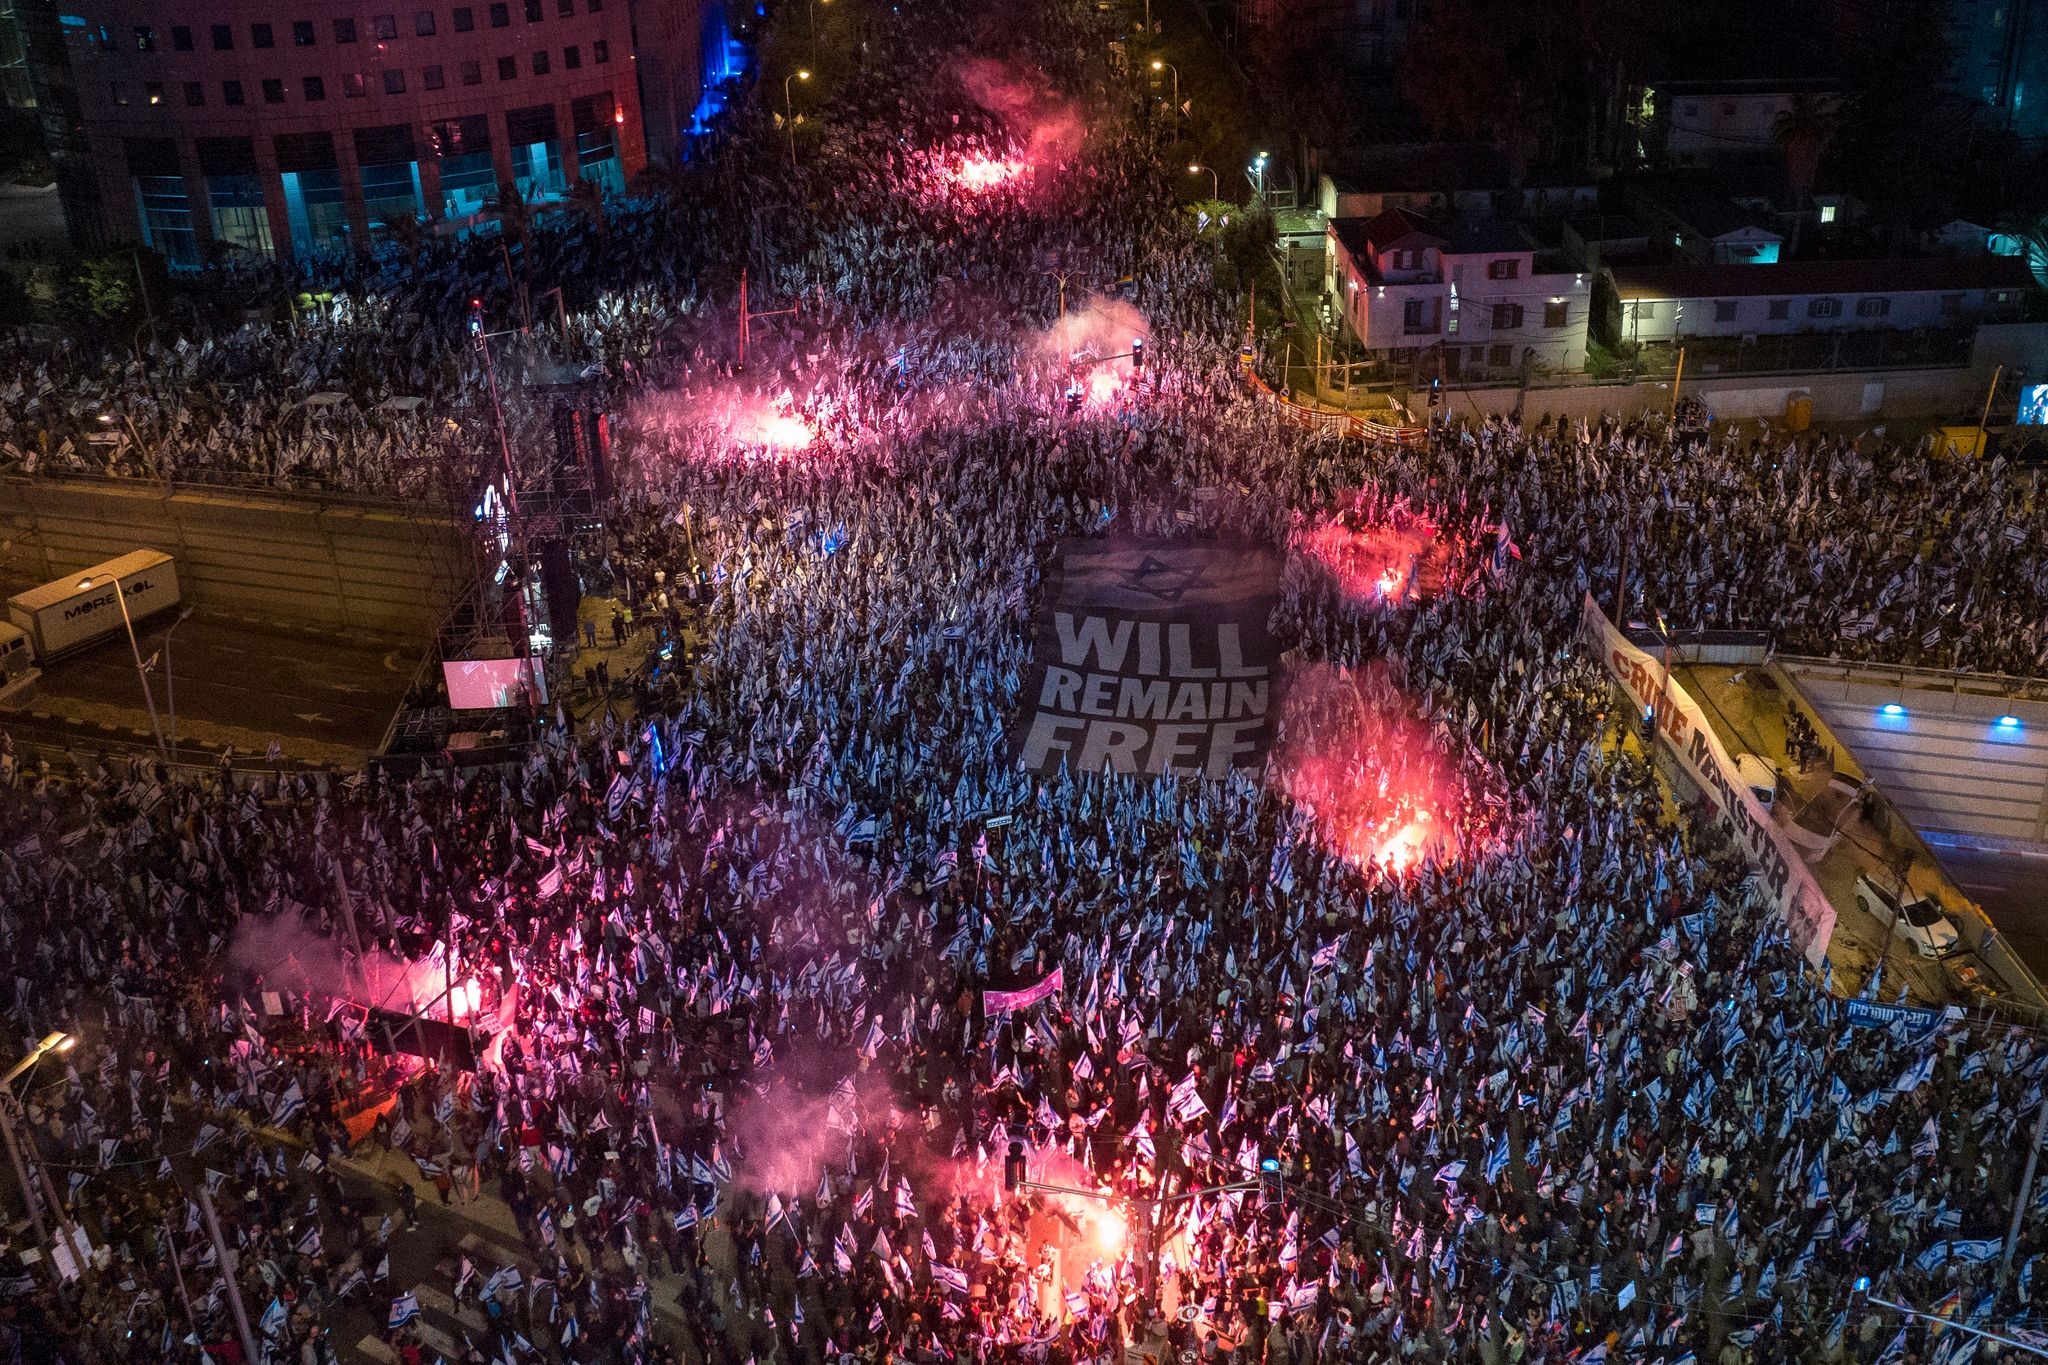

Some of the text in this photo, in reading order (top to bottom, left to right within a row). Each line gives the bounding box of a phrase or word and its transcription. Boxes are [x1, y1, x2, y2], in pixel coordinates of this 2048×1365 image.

[64, 580, 154, 620] MORE KOL
[1055, 612, 1268, 678] WILL
[1039, 666, 1269, 720] REMAIN
[1612, 650, 1689, 746] CRIME
[1023, 712, 1264, 780] FREE
